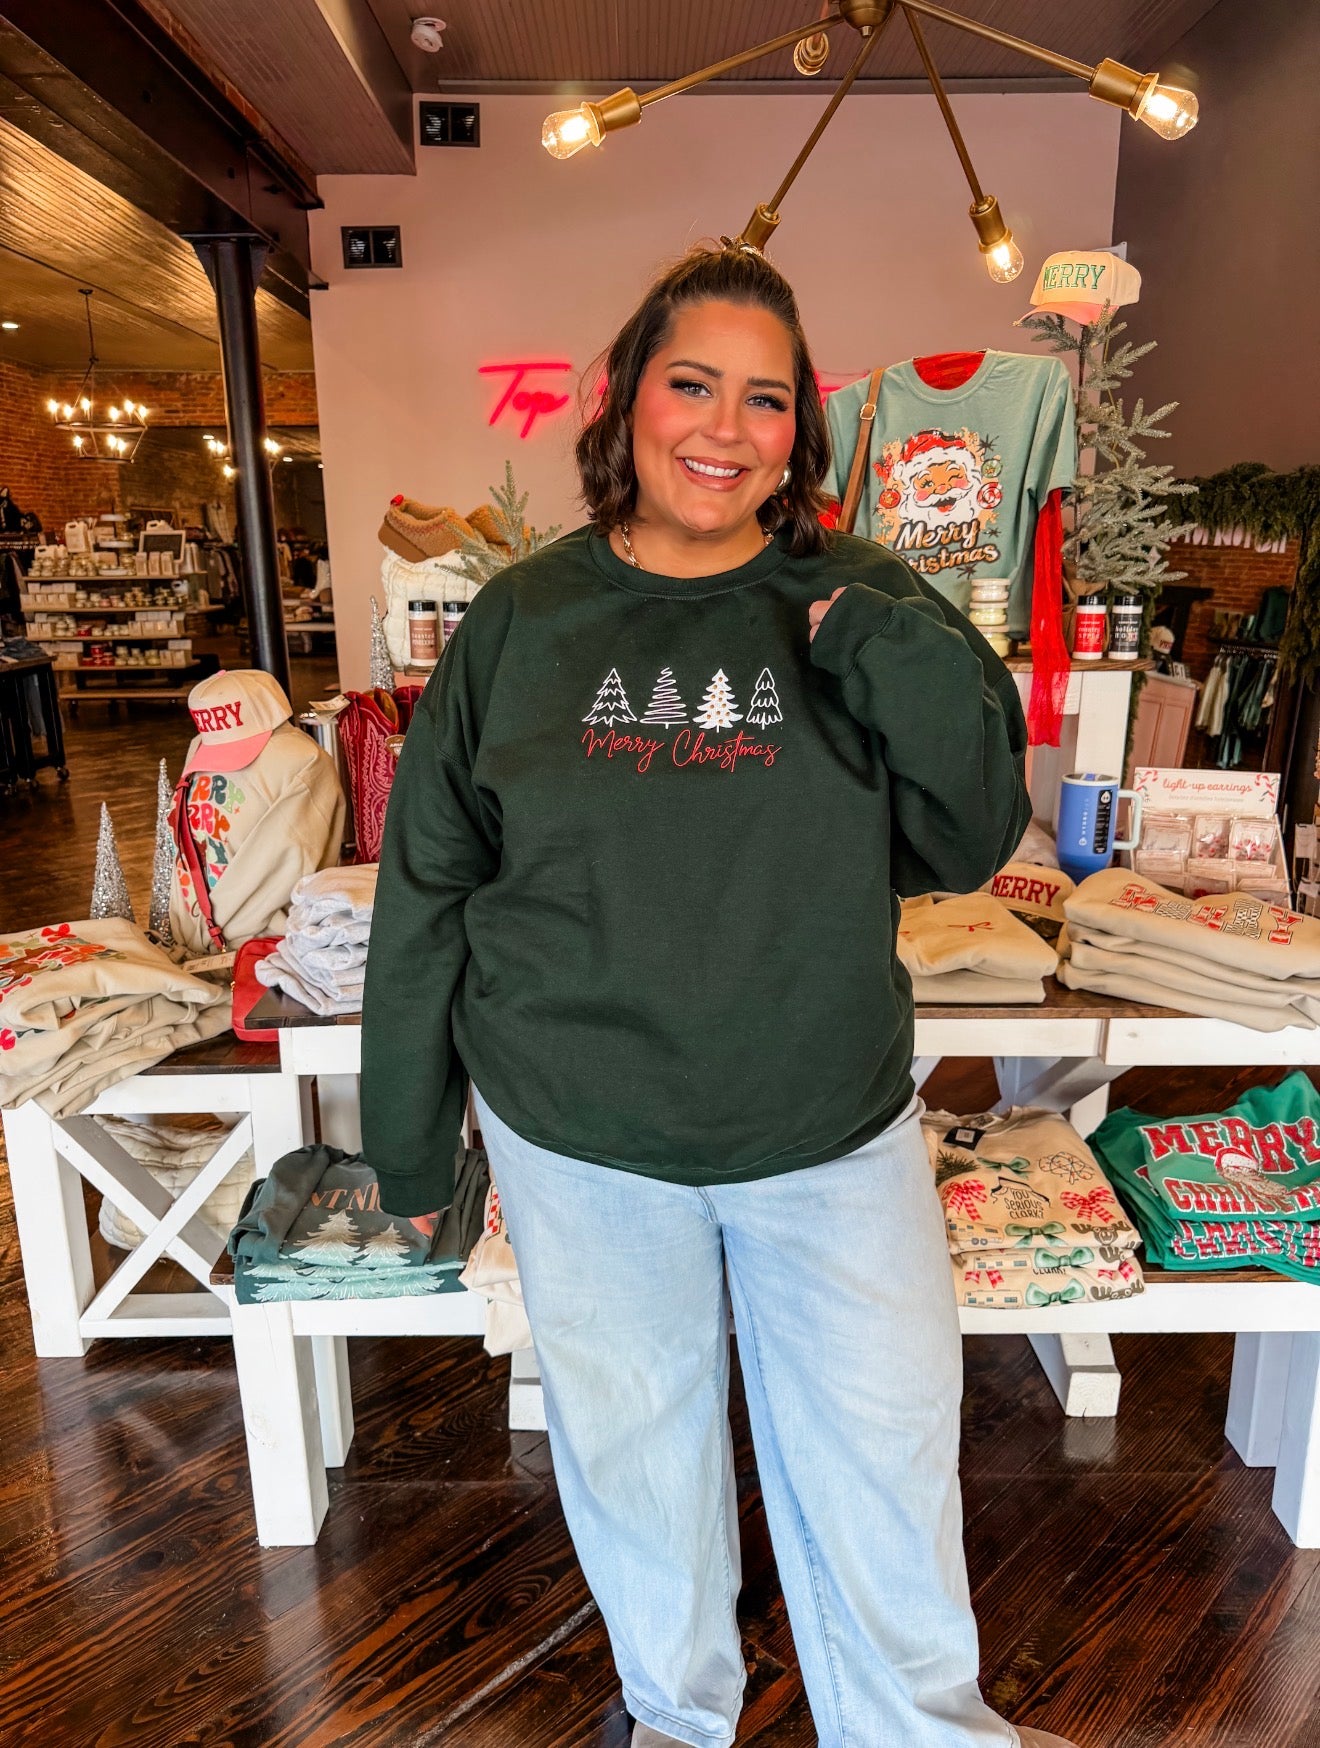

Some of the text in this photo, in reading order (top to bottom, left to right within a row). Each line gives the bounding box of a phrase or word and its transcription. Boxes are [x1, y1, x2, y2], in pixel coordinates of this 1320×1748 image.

[478, 362, 572, 439] Top
[894, 519, 980, 551] Merry
[189, 701, 243, 732] ERRY
[582, 728, 782, 773] Merry Christmas
[1162, 778, 1253, 795] light-up earrings
[1012, 1190, 1030, 1201] YOU
